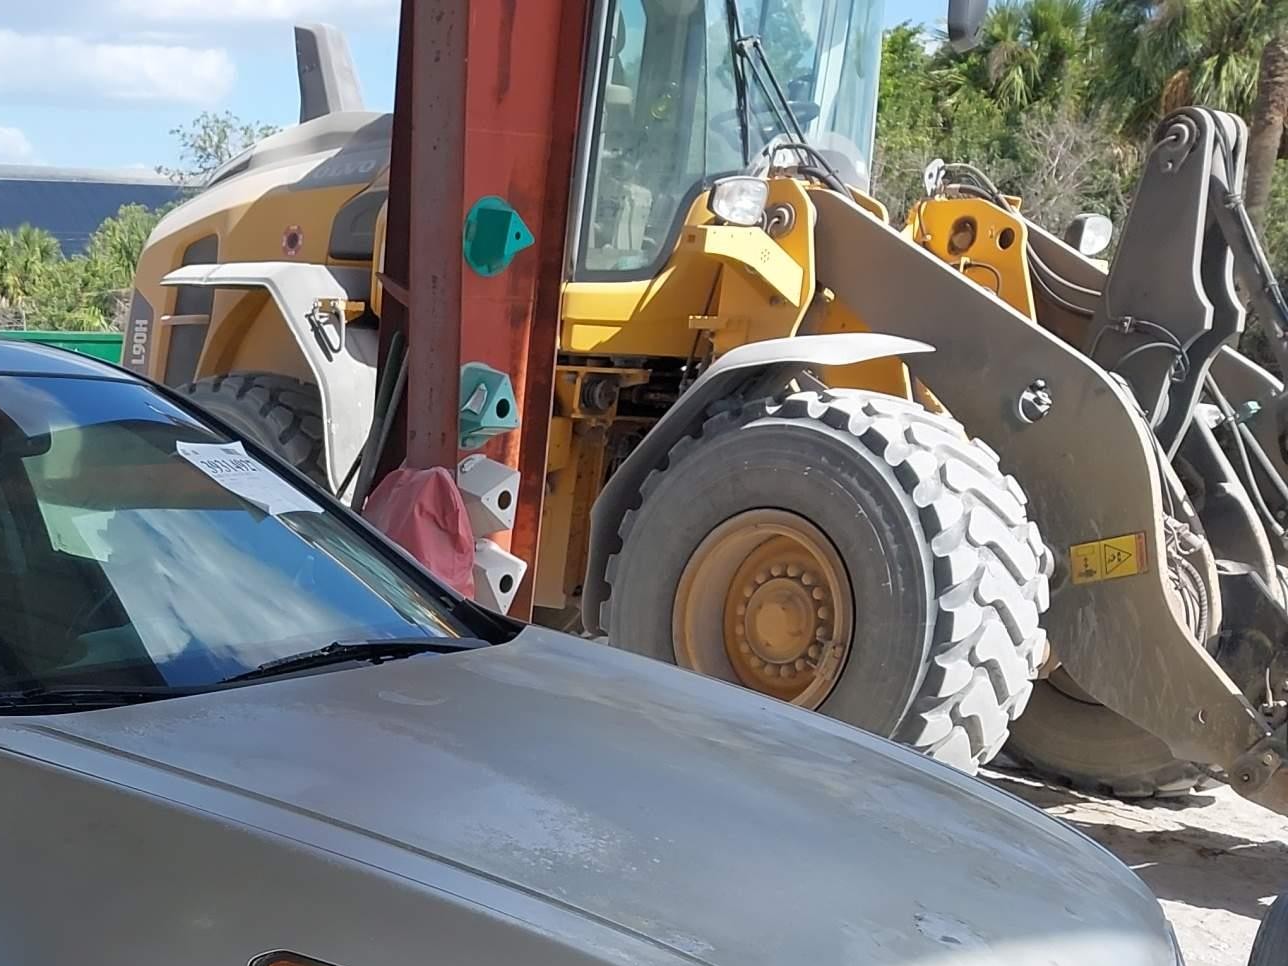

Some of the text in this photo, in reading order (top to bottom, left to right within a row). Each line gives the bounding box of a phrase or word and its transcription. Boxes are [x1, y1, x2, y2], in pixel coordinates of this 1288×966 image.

[304, 159, 377, 181] OLVO
[131, 319, 149, 365] L90H
[199, 458, 260, 475] 3931492
